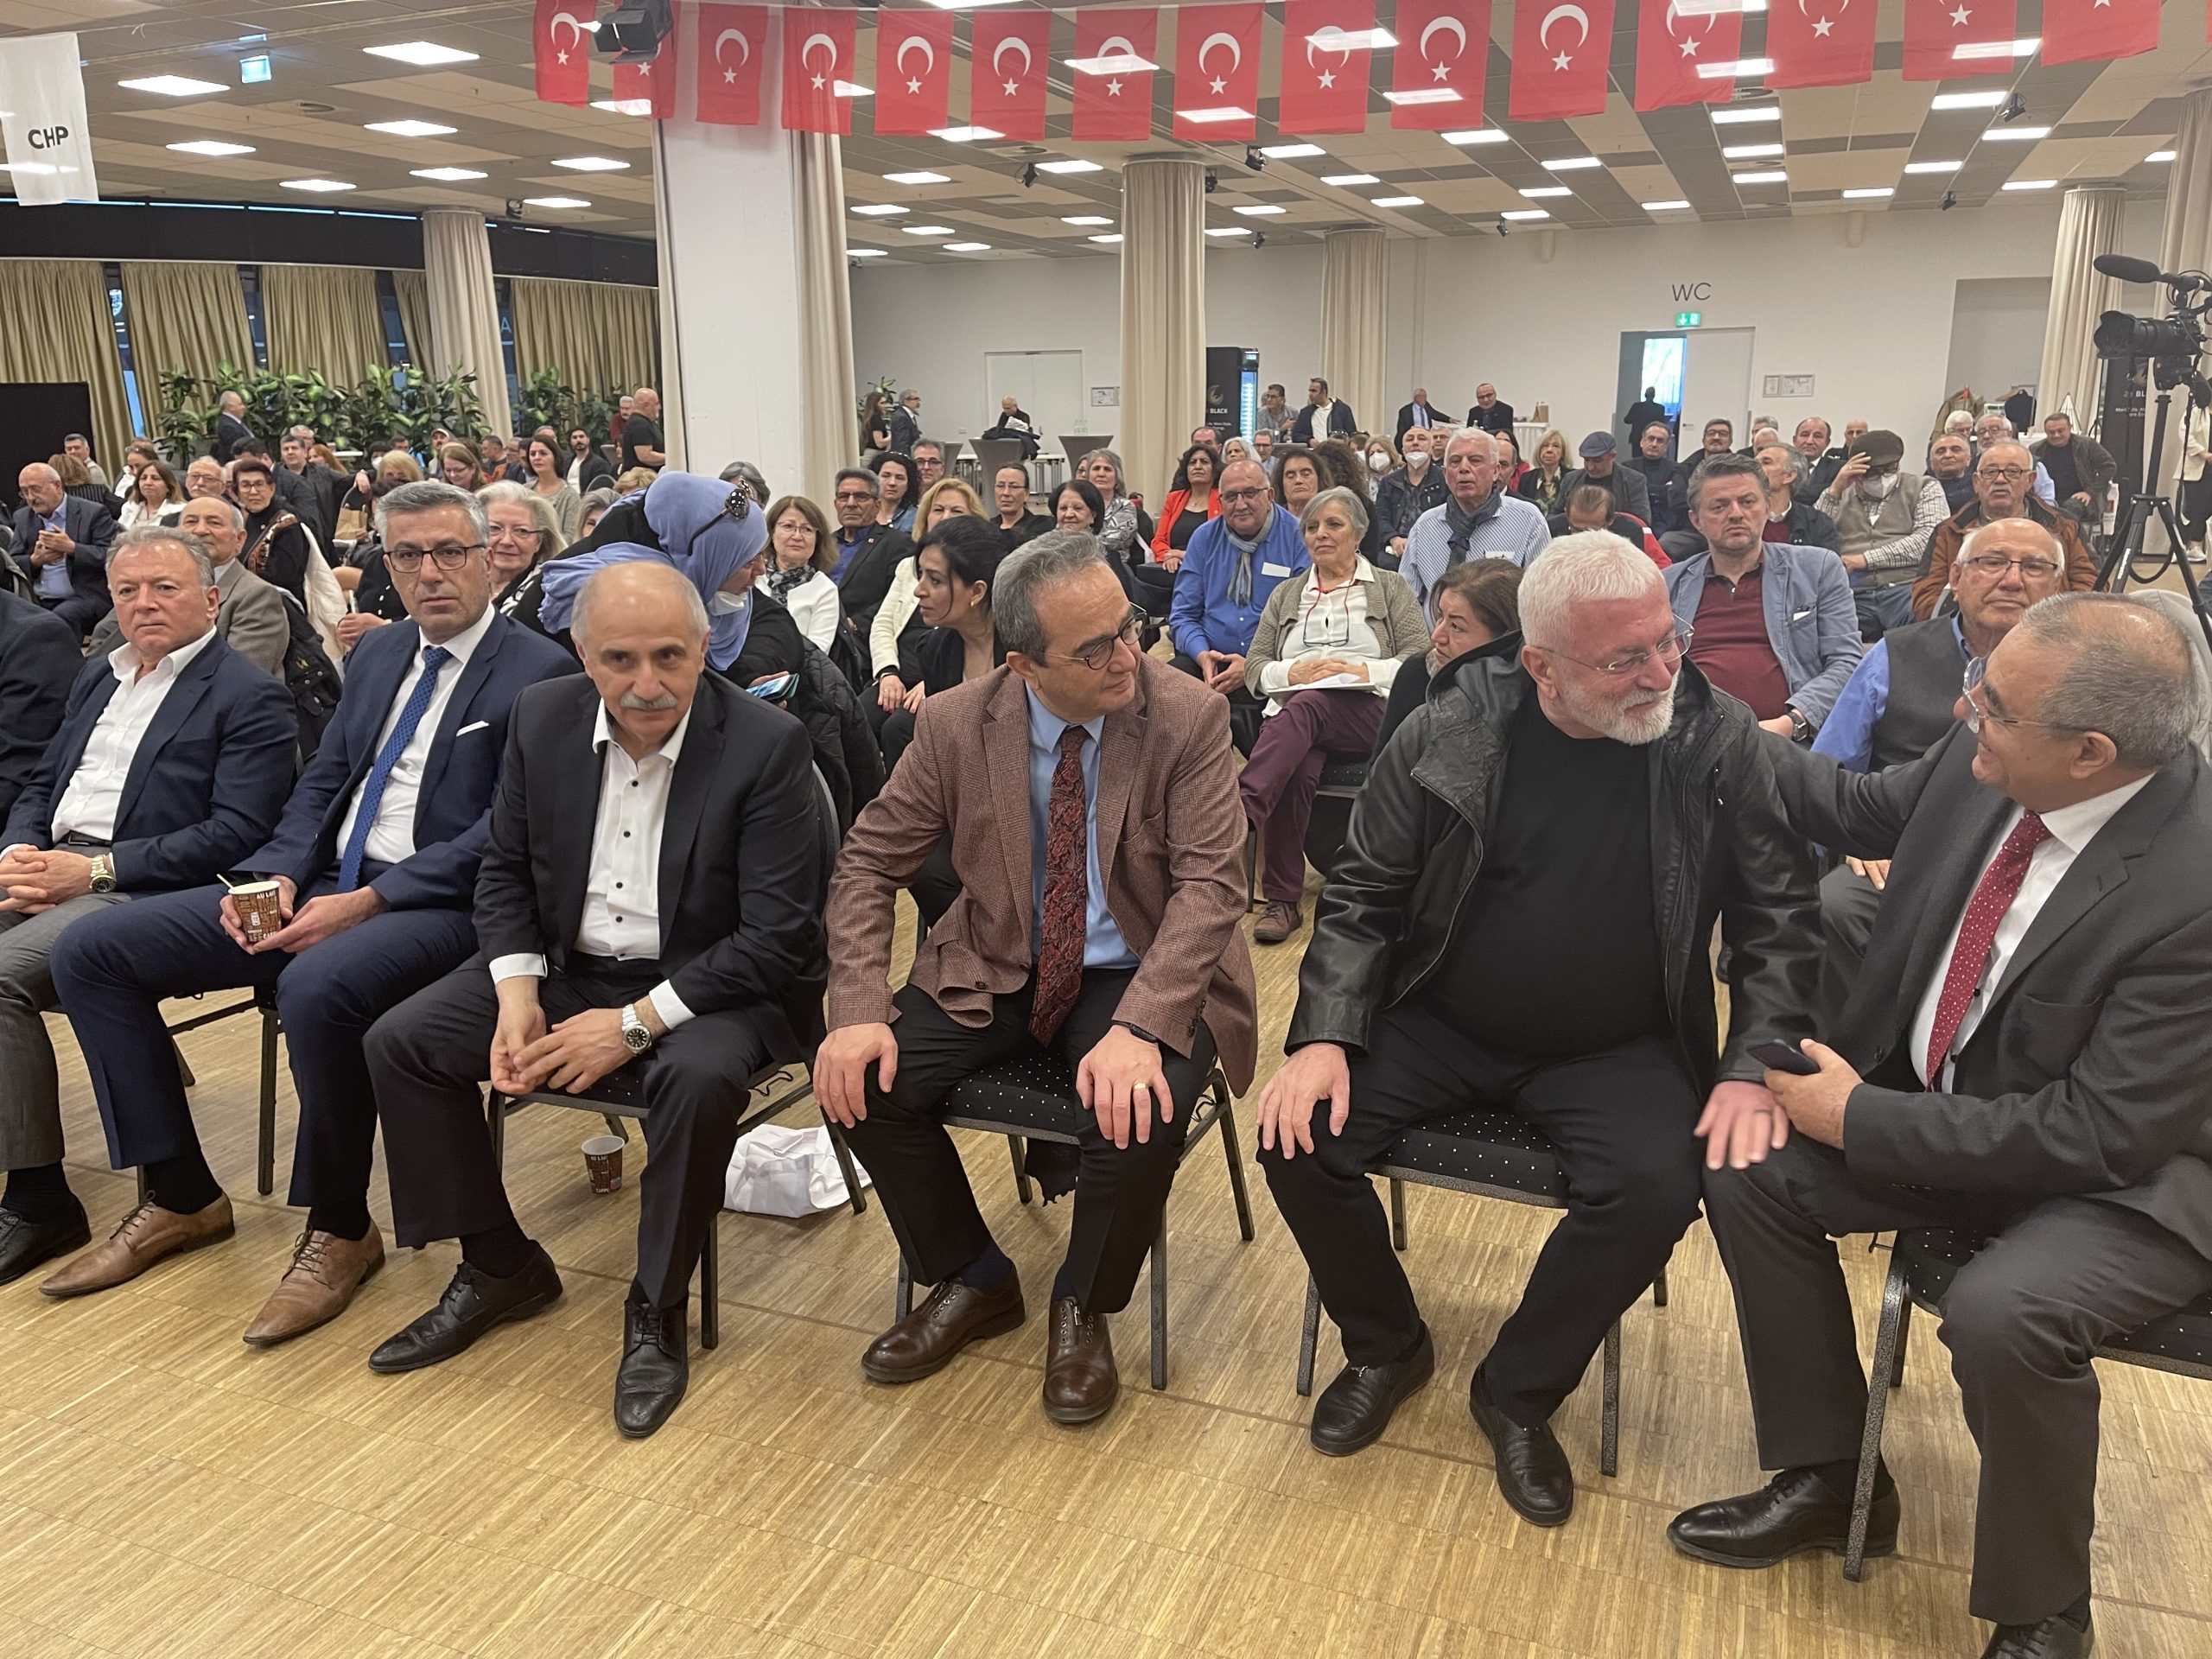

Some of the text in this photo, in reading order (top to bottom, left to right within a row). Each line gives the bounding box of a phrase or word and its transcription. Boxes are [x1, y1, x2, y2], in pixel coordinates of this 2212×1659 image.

[28, 125, 69, 149] CHP
[1672, 282, 1712, 302] WC
[265, 889, 276, 898] LAIT
